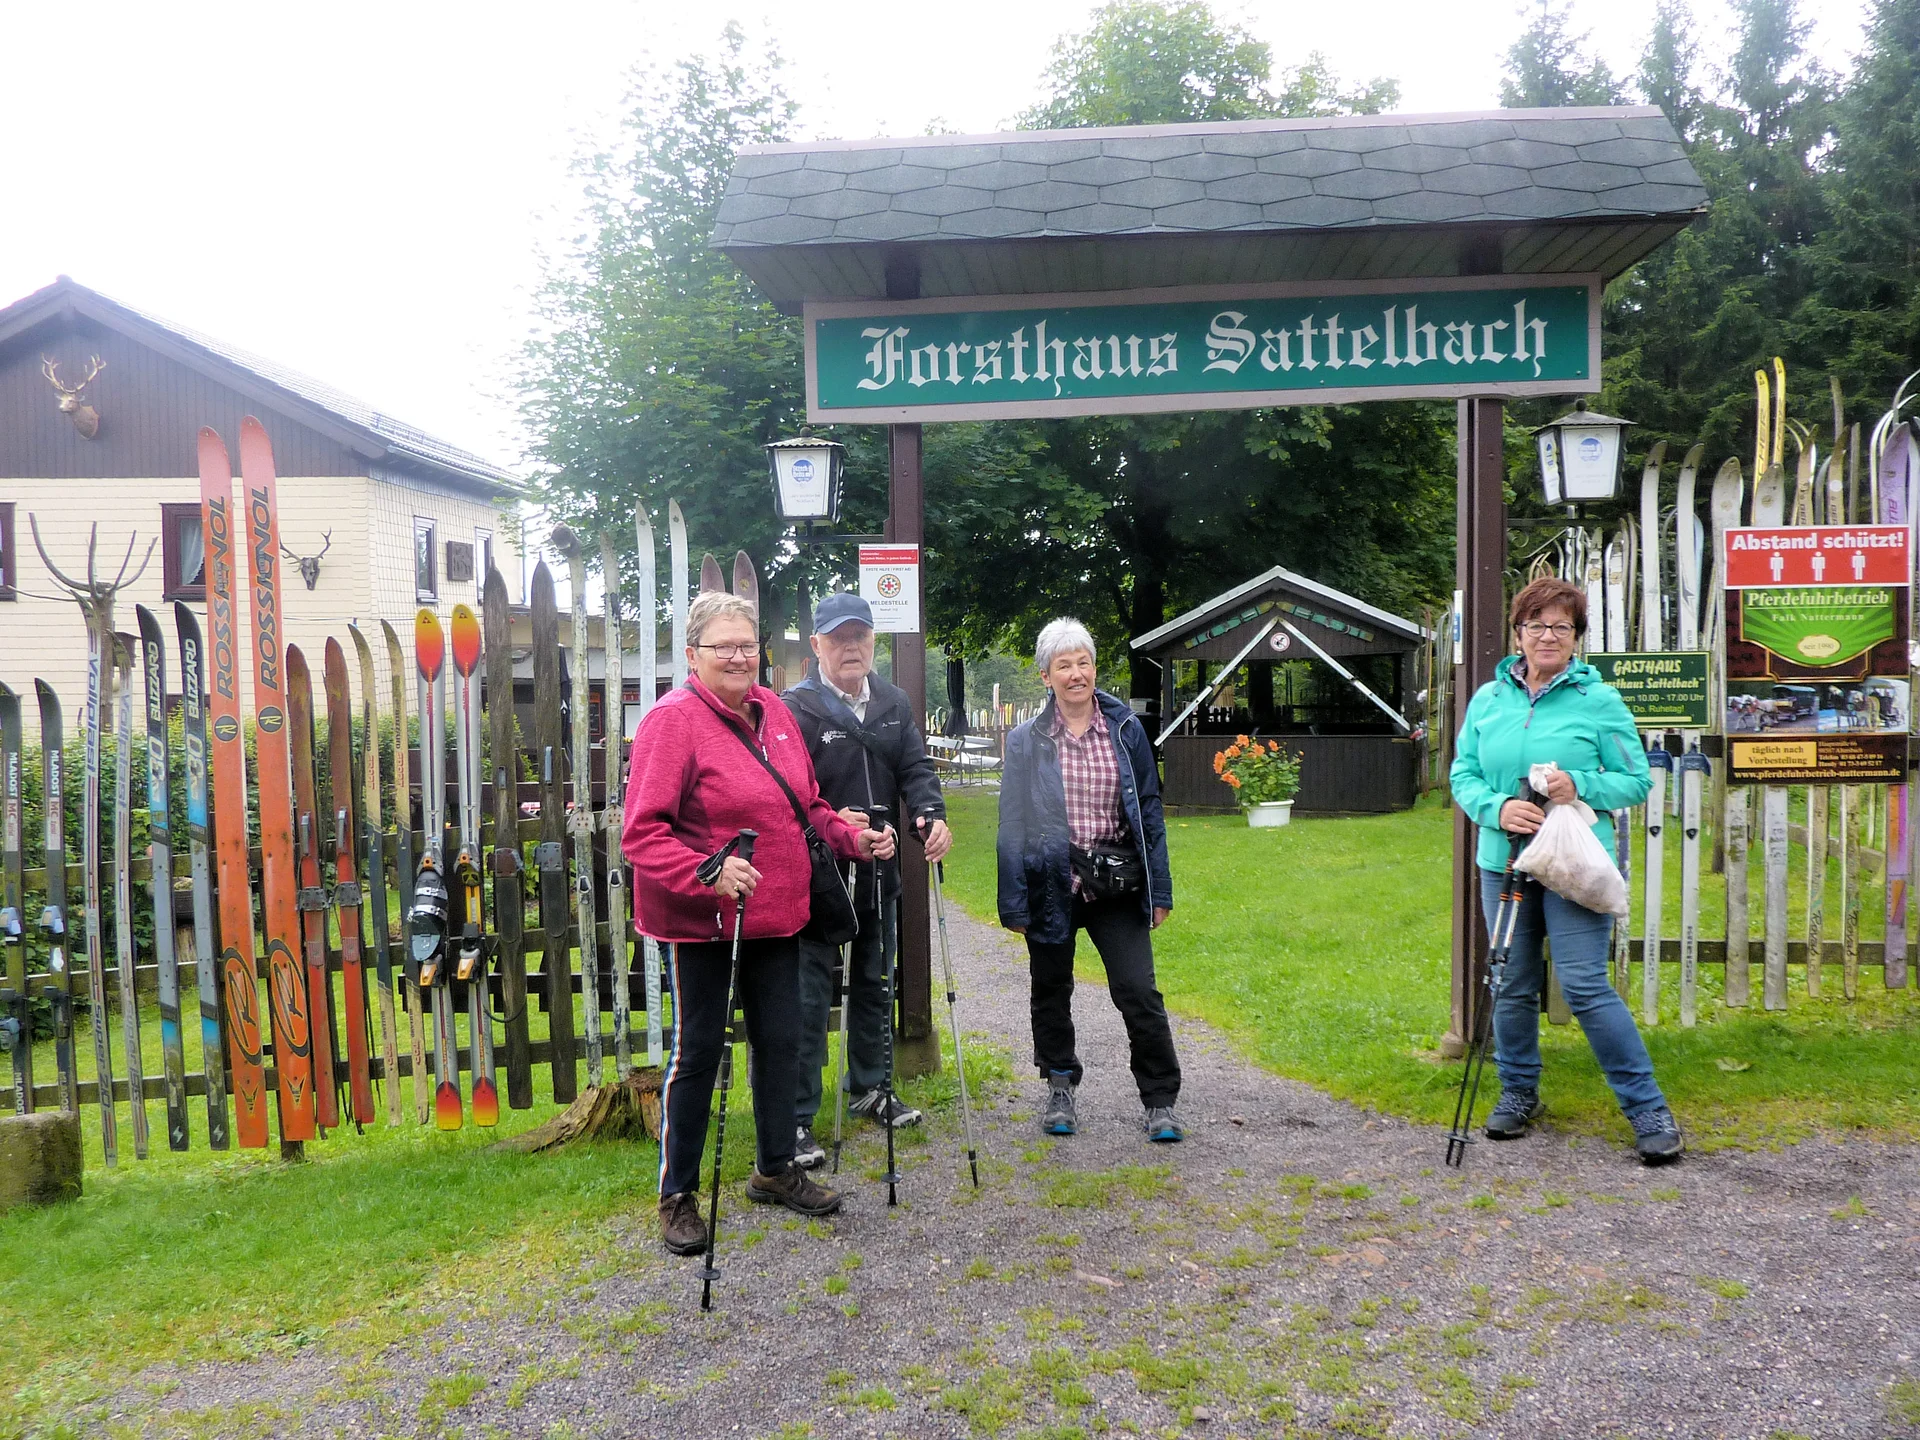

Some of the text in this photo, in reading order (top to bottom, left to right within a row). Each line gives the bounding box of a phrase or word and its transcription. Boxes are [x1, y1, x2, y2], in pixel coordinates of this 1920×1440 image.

[857, 298, 1549, 398] Forsthaus Sattelbach
[1731, 531, 1904, 550] Abstand schützt!
[1747, 590, 1889, 607] Pferdefuhrbetrieb
[1772, 613, 1865, 622] Falk Nattermann
[1612, 660, 1682, 676] GASTHAUS
[148, 641, 161, 722] BLIZZARD
[185, 638, 199, 719] BLIZZARD
[1603, 678, 1644, 689] orsthaus
[87, 658, 99, 773] Vollplast
[1633, 704, 1685, 713] Do. Ruhetag!
[1751, 745, 1804, 755] täglich nach
[1748, 756, 1808, 765] Vorbestellung
[8, 751, 19, 798] MLADOST
[51, 749, 60, 798] MLADOST
[1734, 767, 1901, 780] www.pferdefuhrbetrieb-nattermann.de
[58, 1071, 70, 1111] MLADOS
